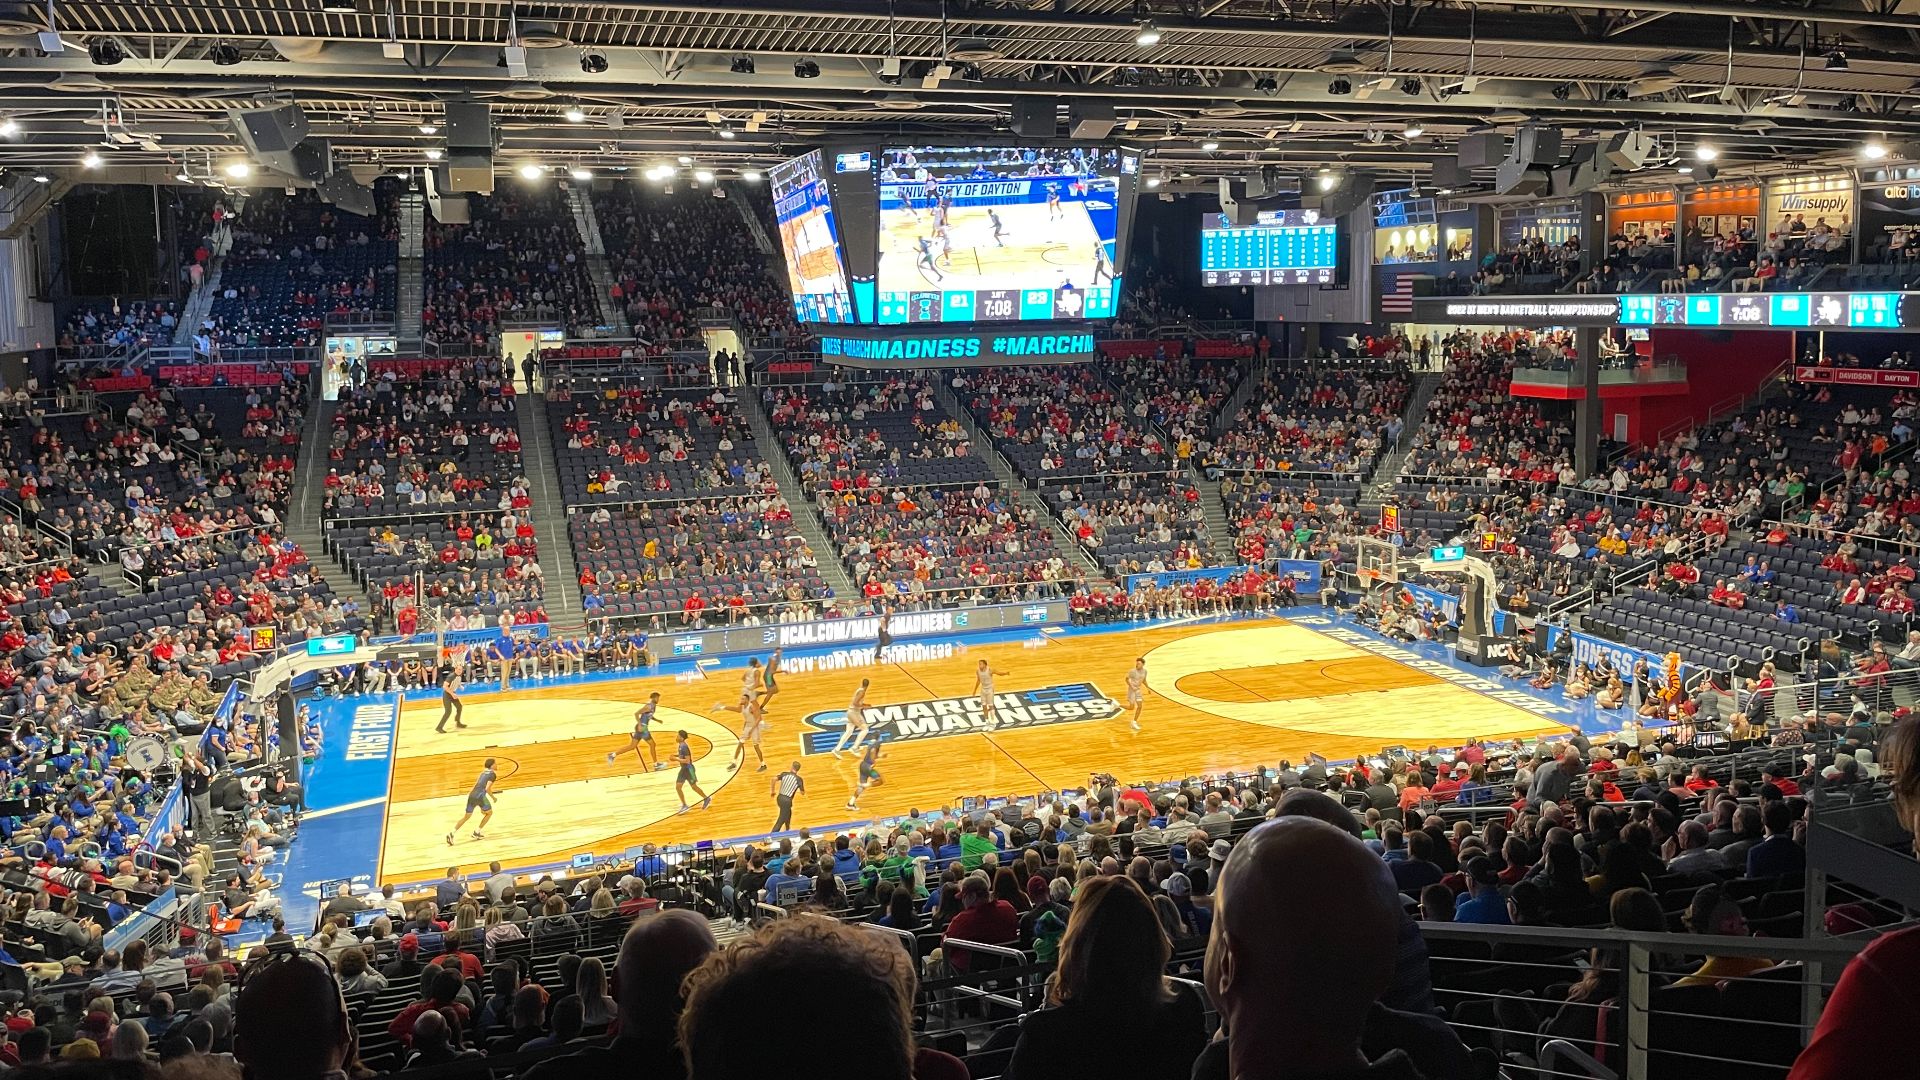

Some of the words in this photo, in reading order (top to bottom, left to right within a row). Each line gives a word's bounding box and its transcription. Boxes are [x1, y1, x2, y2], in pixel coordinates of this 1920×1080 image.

[900, 184, 962, 198] UNIVSITY
[965, 185, 978, 196] OF
[980, 183, 1021, 196] DAYTON
[1782, 195, 1848, 212] Winsupply
[1523, 226, 1581, 242] POWERHO
[950, 294, 968, 308] 21
[984, 300, 1012, 316] 7:08
[1477, 305, 1499, 315] MEN'S
[1500, 305, 1547, 315] BASKETBALL
[1549, 305, 1616, 316] CHAMPIONSHIP
[1732, 306, 1760, 321] 7:08
[1839, 372, 1872, 381] DAVIDSON
[780, 613, 952, 645] NCAA.COM/MARHMADNESS
[420, 635, 433, 643] THE
[1318, 628, 1371, 640] THE
[1349, 641, 1422, 660] ROAD
[1405, 660, 1504, 690] STARTS
[1484, 690, 1573, 714] HERE
[352, 704, 394, 730] FOUR
[346, 731, 391, 760] FIRST
